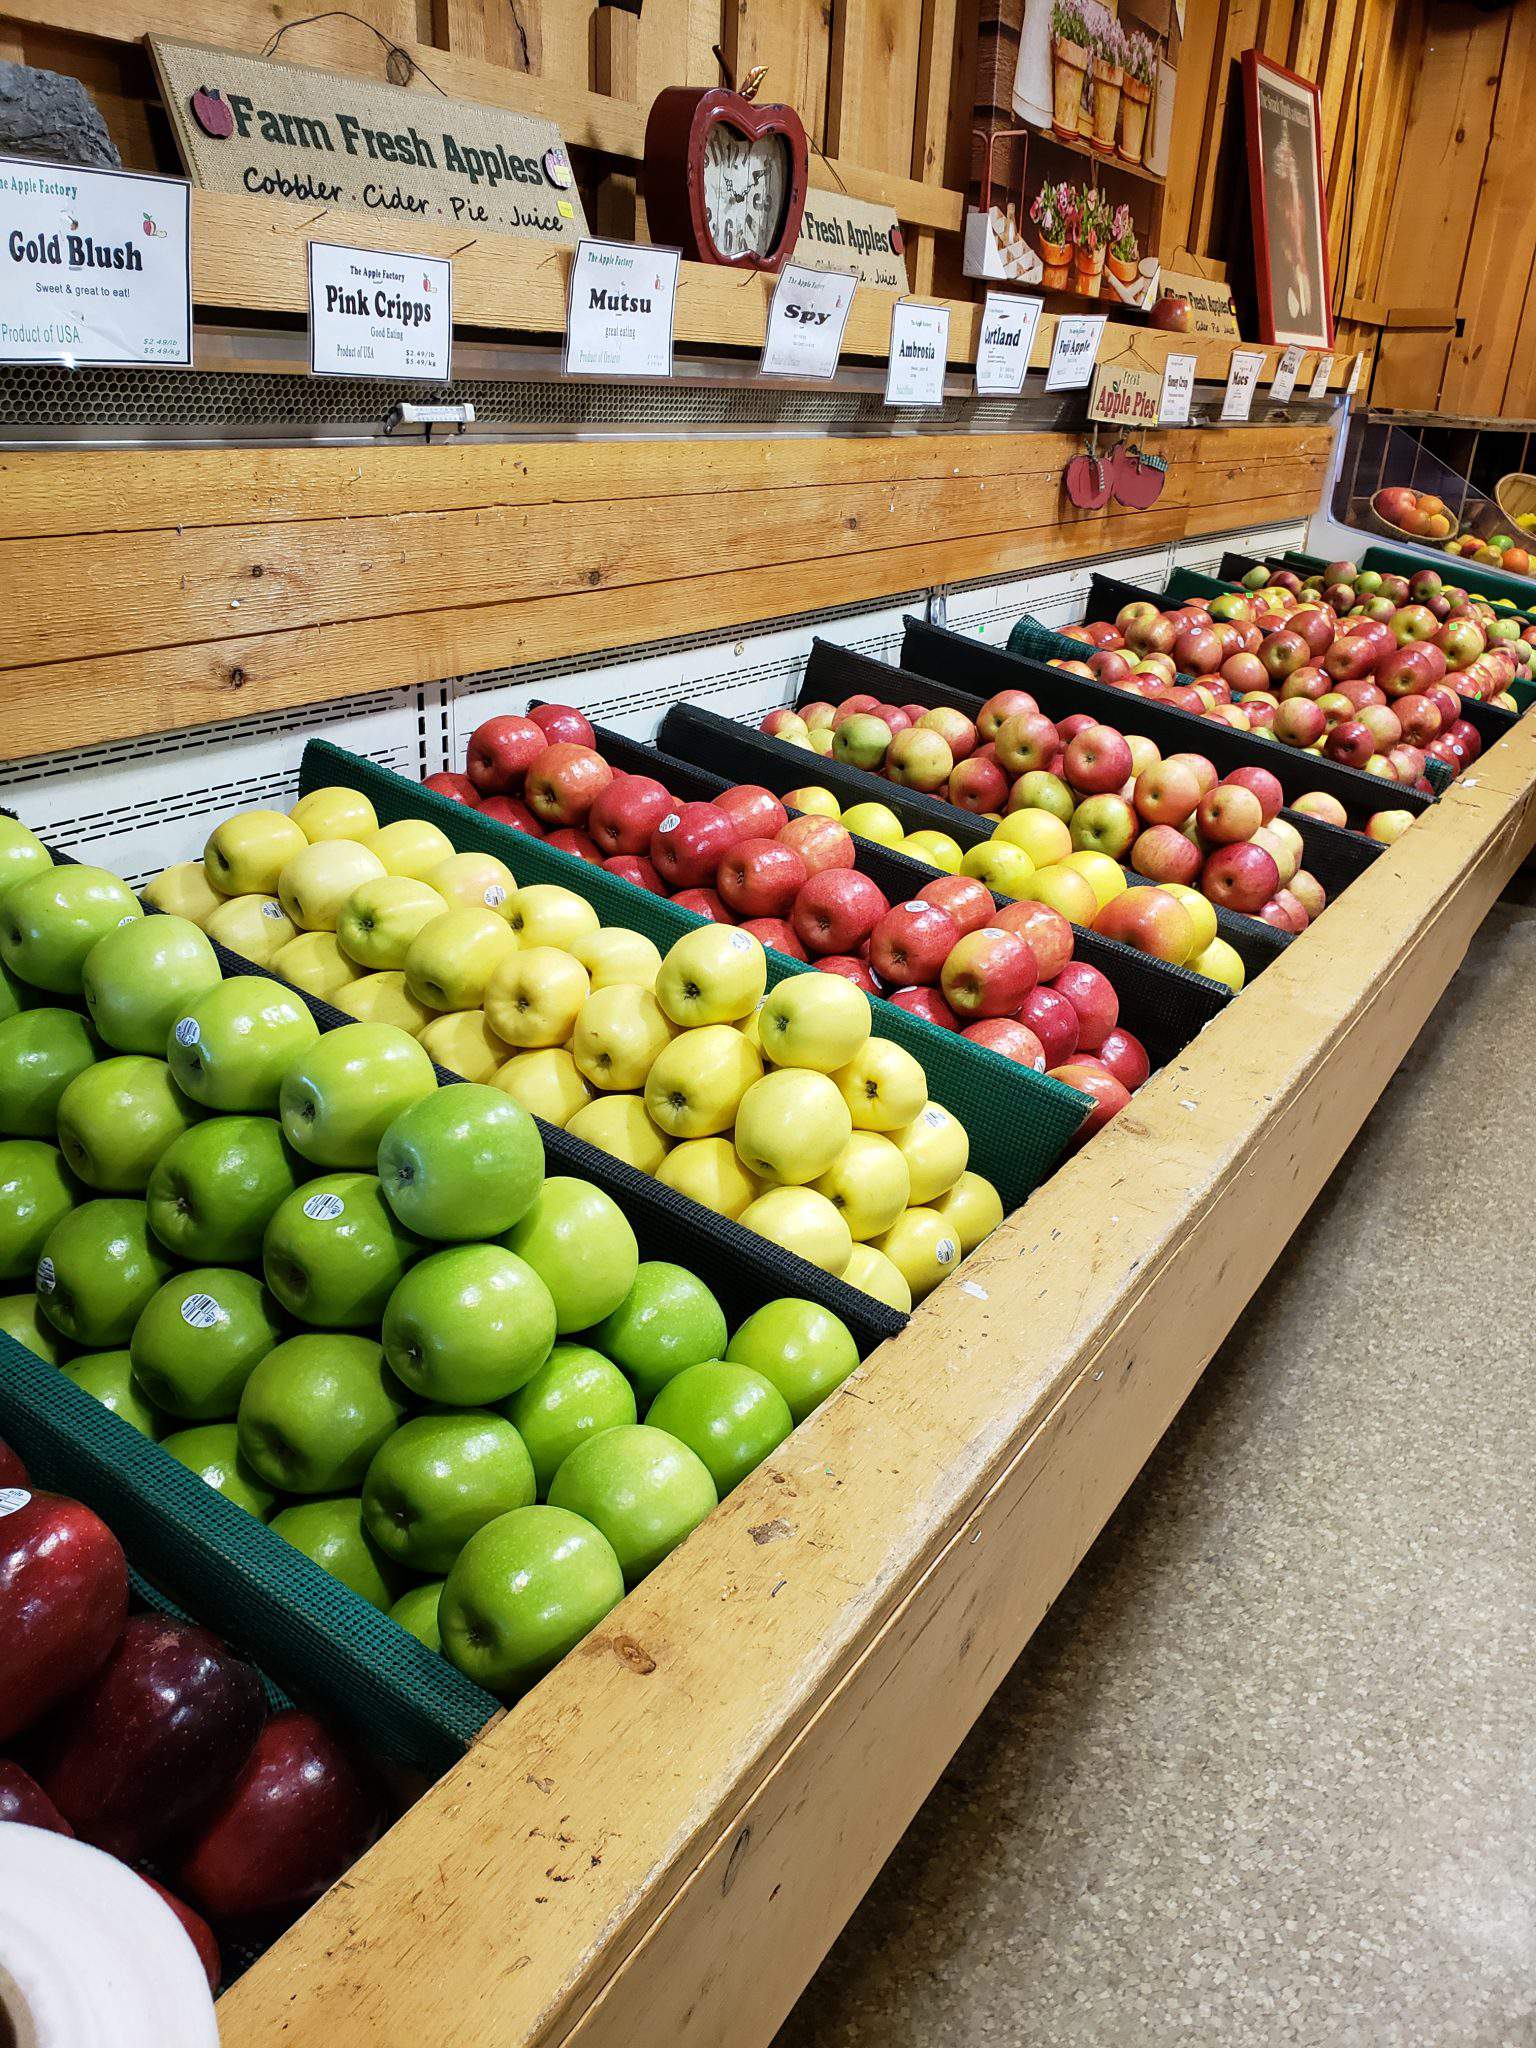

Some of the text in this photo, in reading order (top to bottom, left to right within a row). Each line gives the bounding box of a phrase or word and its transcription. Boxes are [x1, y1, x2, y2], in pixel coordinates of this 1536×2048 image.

[227, 94, 543, 187] Farm Fresh Apples
[11, 176, 37, 196] Apple
[39, 178, 78, 200] Factory
[243, 167, 563, 231] Cobbler Cider Pie Juice
[804, 211, 845, 245] Fresh
[847, 219, 889, 256] Apples
[8, 230, 143, 271] Gold Blush
[350, 265, 405, 283] The Apple Factory
[875, 268, 897, 286] Juice
[36, 282, 130, 298] Sweet & great to eat!
[325, 284, 431, 327] Pink Cripps
[589, 288, 652, 313] Mutsu
[784, 304, 831, 325] Spy
[2, 323, 40, 343] Product
[42, 324, 54, 342] of
[370, 326, 404, 342] Good Eating
[605, 326, 636, 340] great eating
[336, 344, 374, 359] Product of USA
[899, 339, 935, 359] Ambrosia
[1070, 339, 1090, 356] Apple
[1232, 370, 1249, 386] Macs
[1096, 386, 1156, 419] Apple Pies
